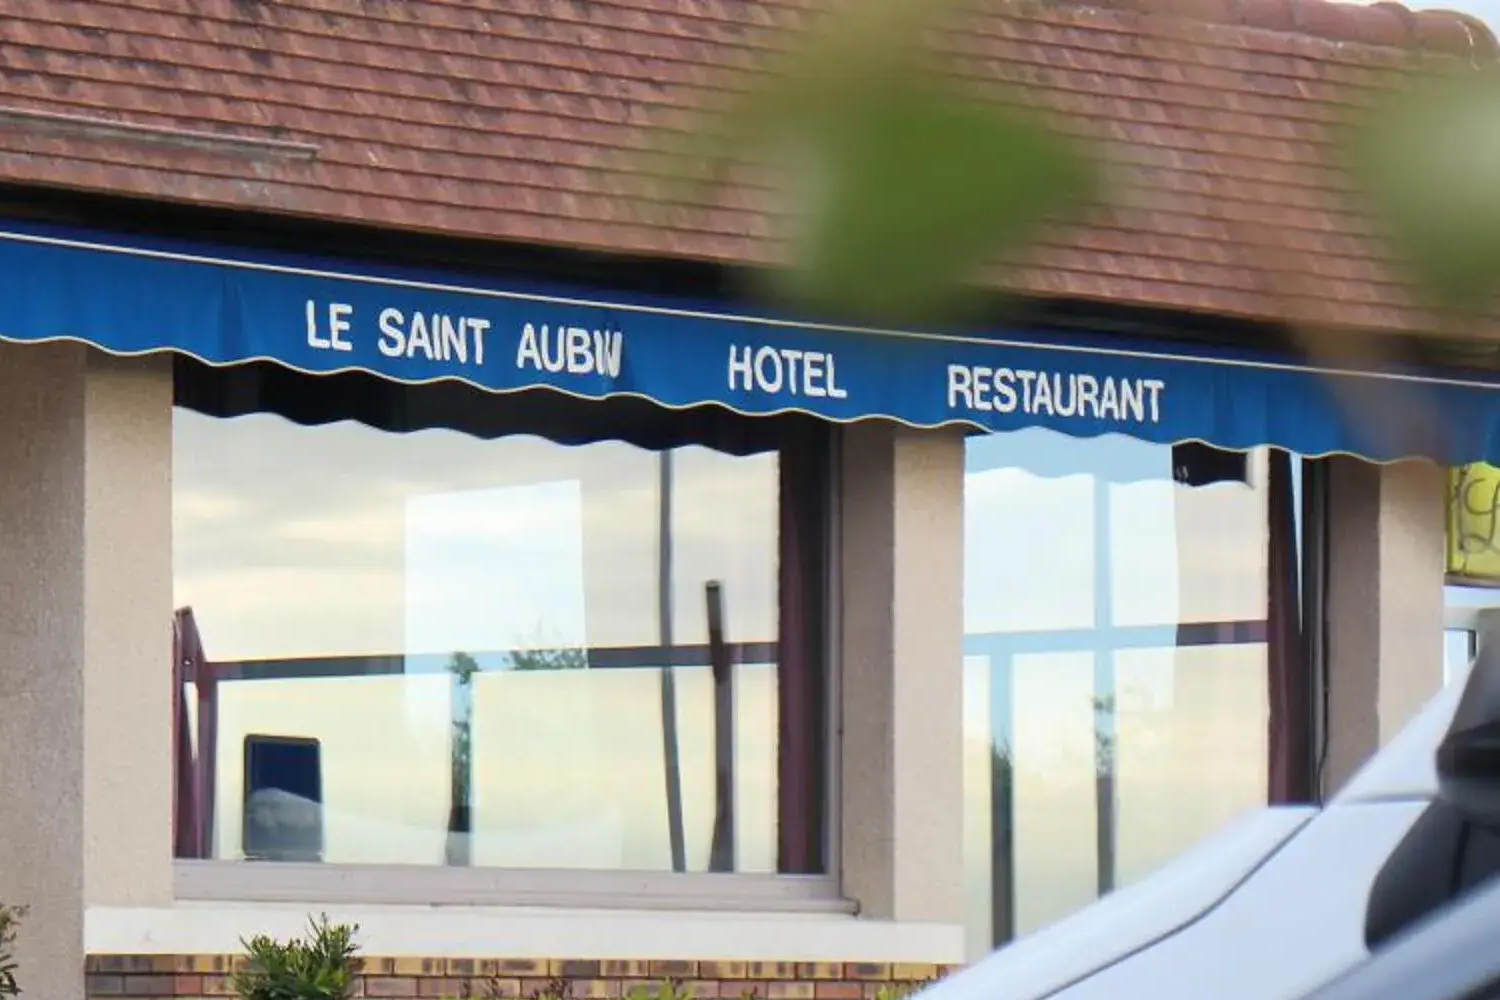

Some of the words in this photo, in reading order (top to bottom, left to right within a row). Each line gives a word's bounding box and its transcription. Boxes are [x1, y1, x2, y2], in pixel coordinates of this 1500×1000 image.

[306, 299, 353, 351] LE
[377, 307, 491, 365] SAINT
[728, 343, 848, 398] HOTEL
[947, 363, 1165, 423] RESTAURANT
